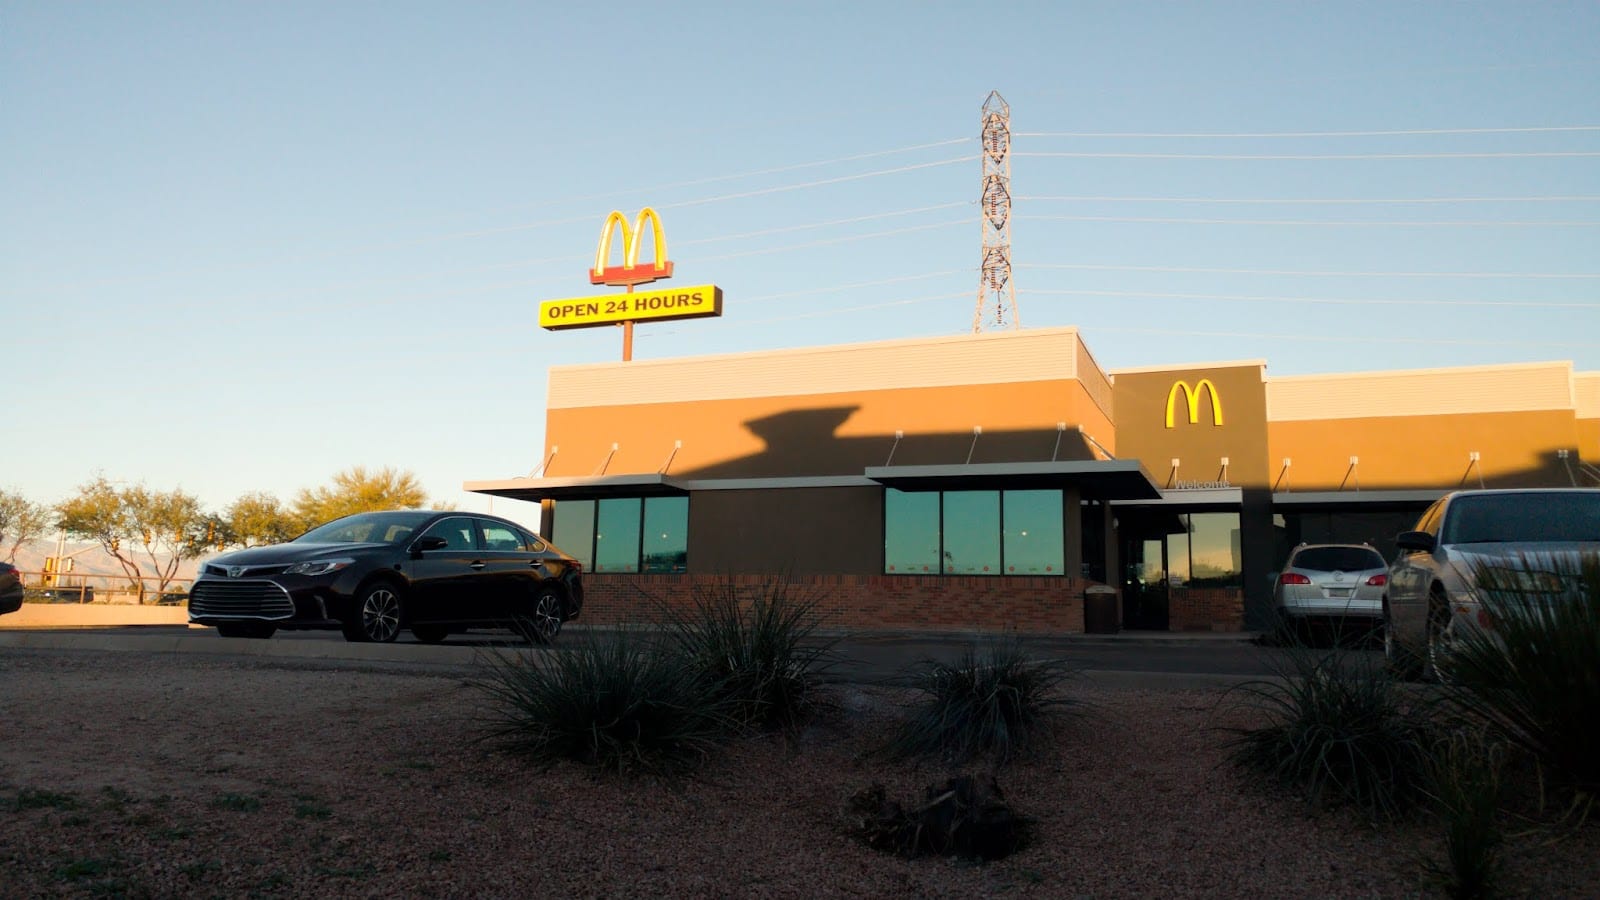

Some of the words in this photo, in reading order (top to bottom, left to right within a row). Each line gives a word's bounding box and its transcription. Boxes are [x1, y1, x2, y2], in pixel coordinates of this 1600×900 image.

[549, 302, 599, 319] OPEN
[605, 300, 629, 314] 24
[635, 292, 703, 311] HOURS
[1174, 479, 1231, 489] Welcome
